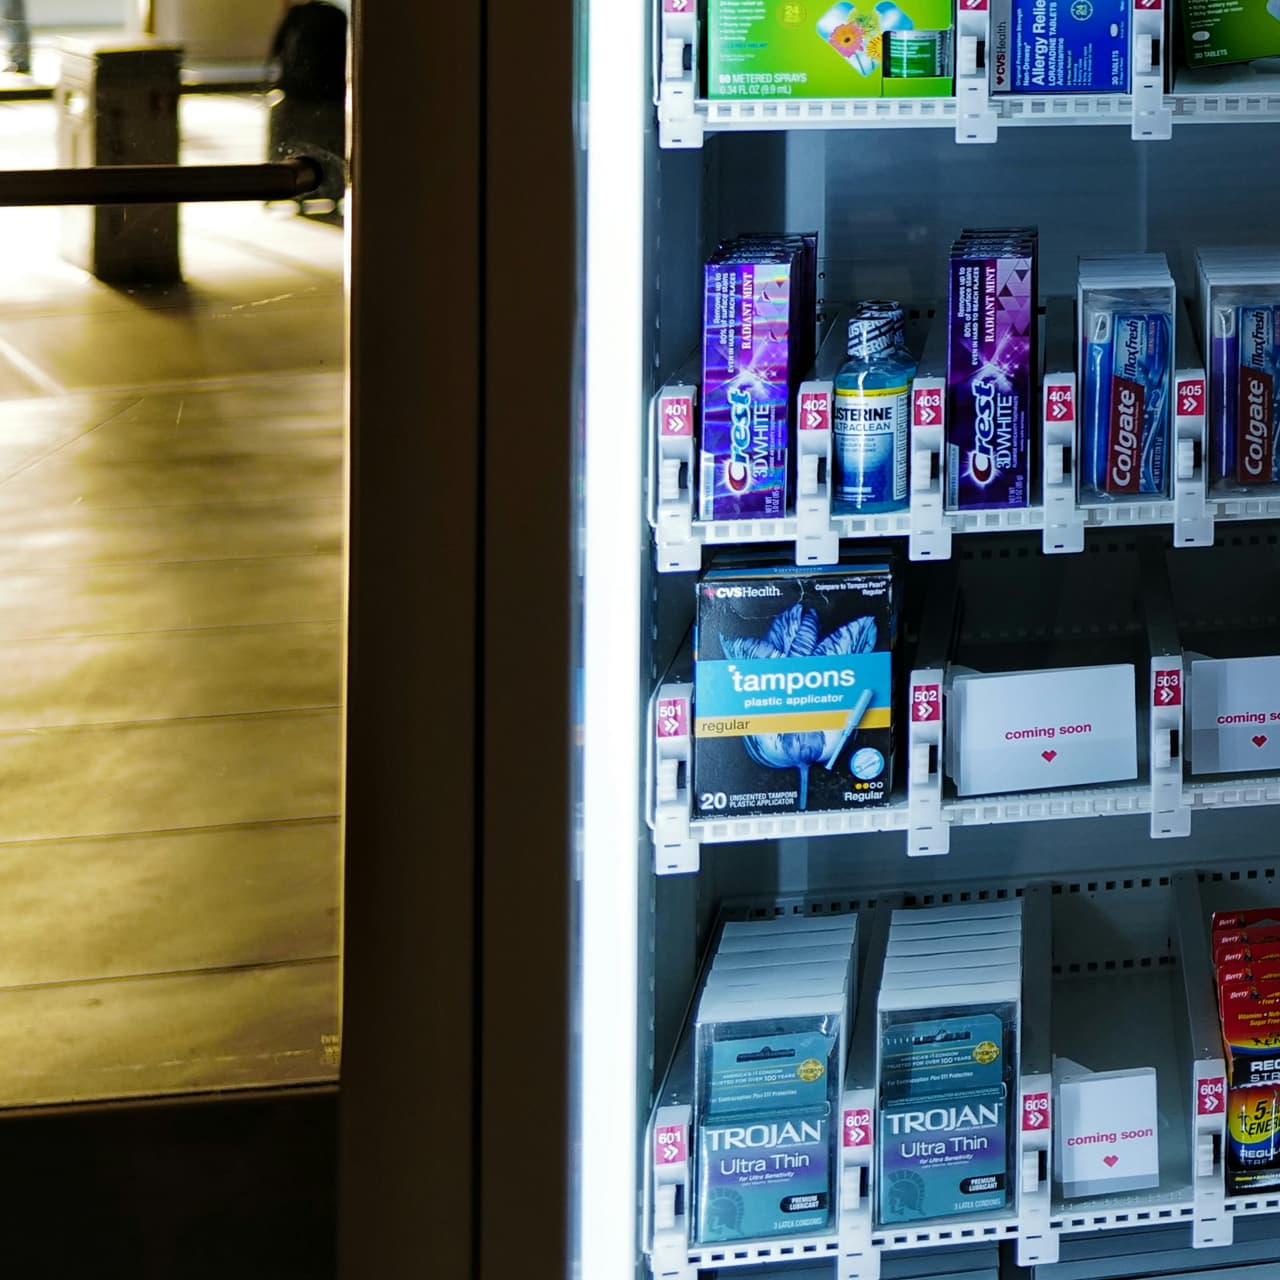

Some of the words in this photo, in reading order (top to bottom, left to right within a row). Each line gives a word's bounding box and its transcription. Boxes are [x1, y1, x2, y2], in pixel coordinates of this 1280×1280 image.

[985, 267, 995, 299] MINT
[985, 302, 995, 342] RADIANT
[1049, 391, 1070, 402] 404
[665, 404, 686, 417] 401
[1112, 388, 1136, 487] Colgate
[732, 667, 855, 693] tampons
[744, 696, 778, 708] plastic
[781, 693, 843, 707] applicator
[915, 691, 937, 701] 502
[701, 719, 750, 732] regular
[1005, 727, 1056, 740] coming
[1059, 723, 1092, 735] soon
[1200, 1083, 1222, 1095] 604
[846, 1115, 869, 1126] 602
[707, 1126, 821, 1151] TROJAN
[1067, 1131, 1117, 1146] coming
[1121, 1126, 1153, 1139] soon
[720, 1156, 769, 1175] Ultra
[774, 1152, 809, 1168] Thin
